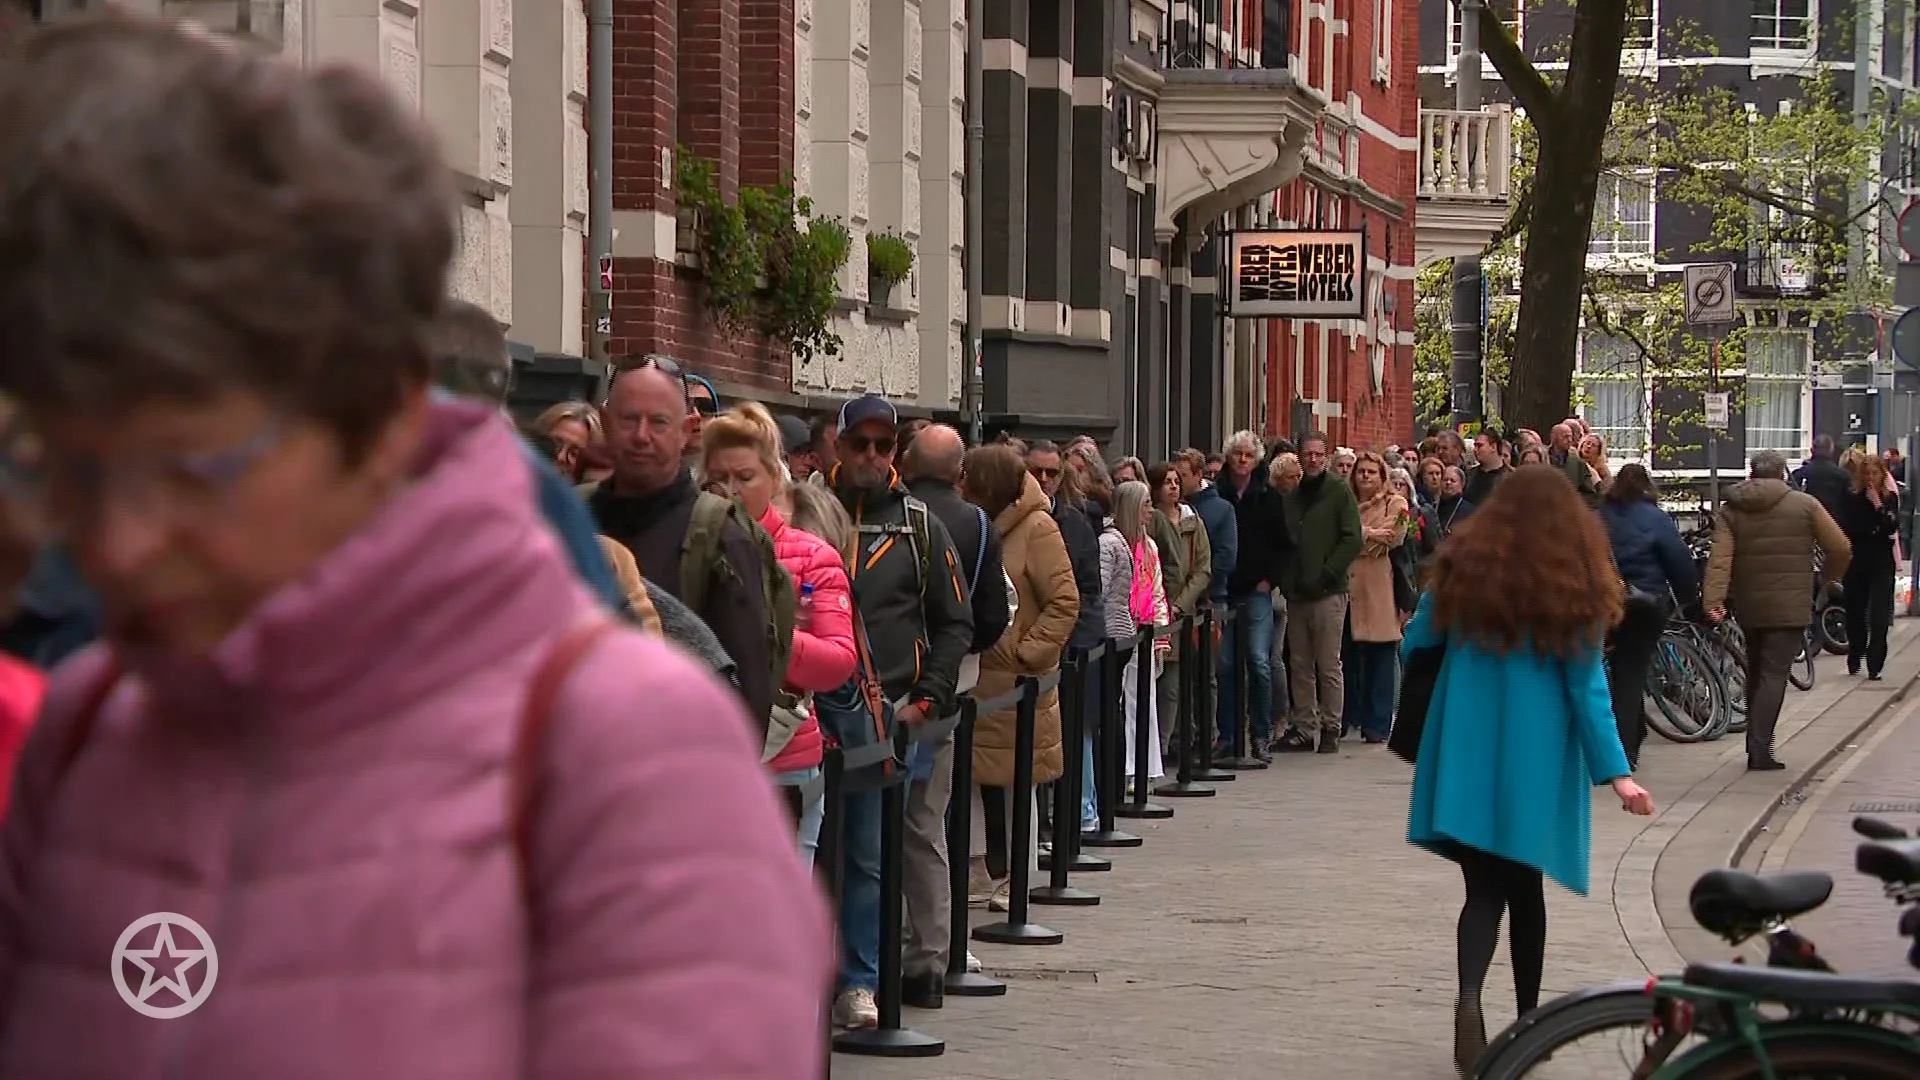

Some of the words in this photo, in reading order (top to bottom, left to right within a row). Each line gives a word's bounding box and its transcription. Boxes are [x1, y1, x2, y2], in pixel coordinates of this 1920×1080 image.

[1240, 244, 1270, 302] WEBER
[1270, 244, 1297, 302] HOTELS
[1298, 243, 1355, 274] WEBER
[1298, 274, 1354, 302] HOTELS
